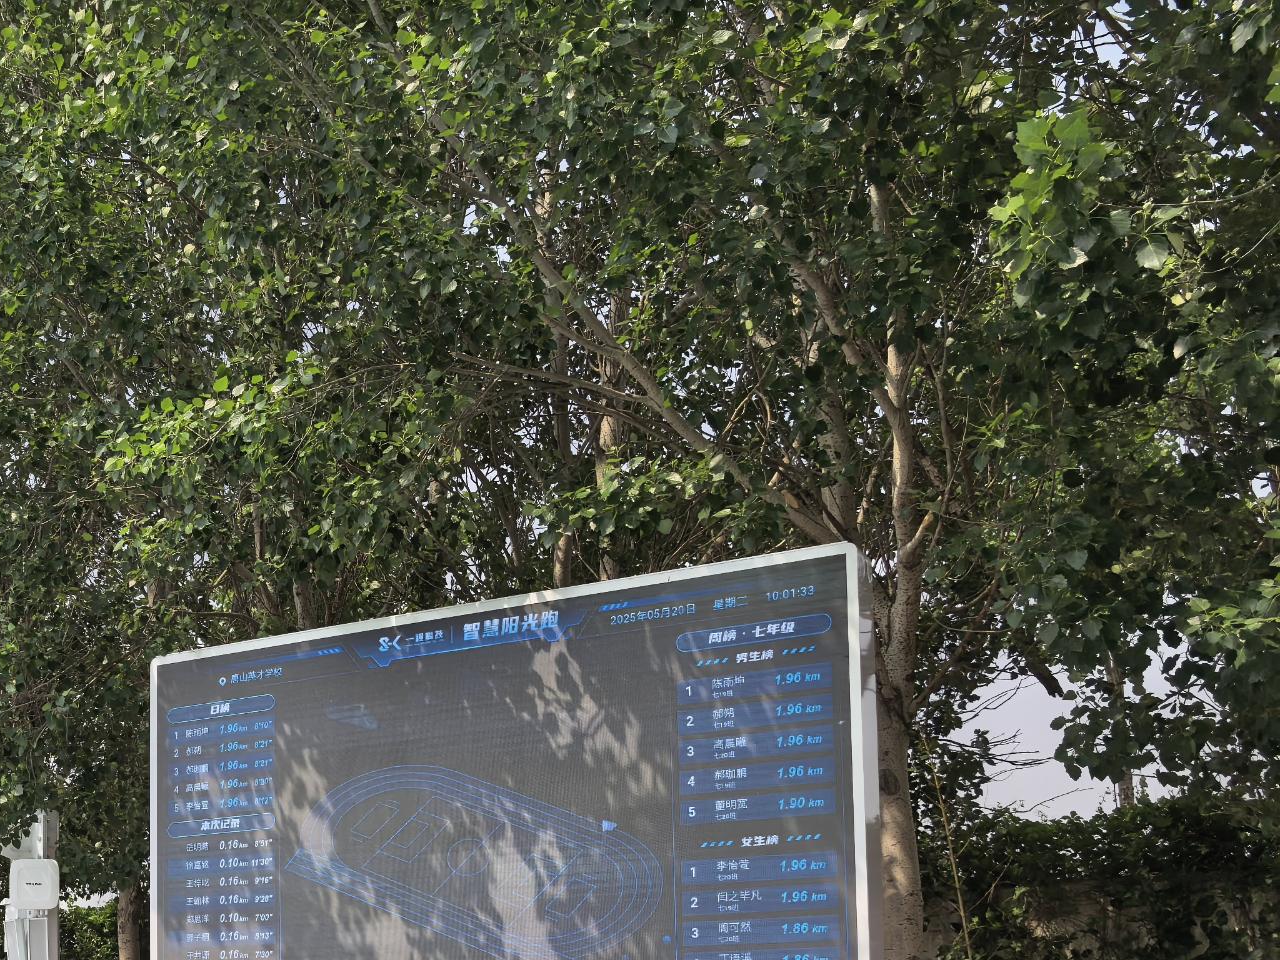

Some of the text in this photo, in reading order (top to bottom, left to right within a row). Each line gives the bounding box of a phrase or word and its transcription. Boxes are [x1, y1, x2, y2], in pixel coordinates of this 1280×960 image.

[610, 585, 814, 625] 2025年05月20日 星期二 10:01:33
[463, 610, 559, 641] 智慧阳光跑
[736, 650, 774, 663] 男生榜
[686, 686, 692, 697] 1
[211, 703, 230, 715] 日榜
[686, 716, 694, 727] 2
[687, 746, 694, 757] 3
[687, 776, 695, 787] 4
[689, 807, 696, 817] 5
[741, 835, 779, 847] 女生榜
[690, 867, 696, 877] 1
[690, 897, 699, 908] 2
[691, 928, 699, 938] 3
